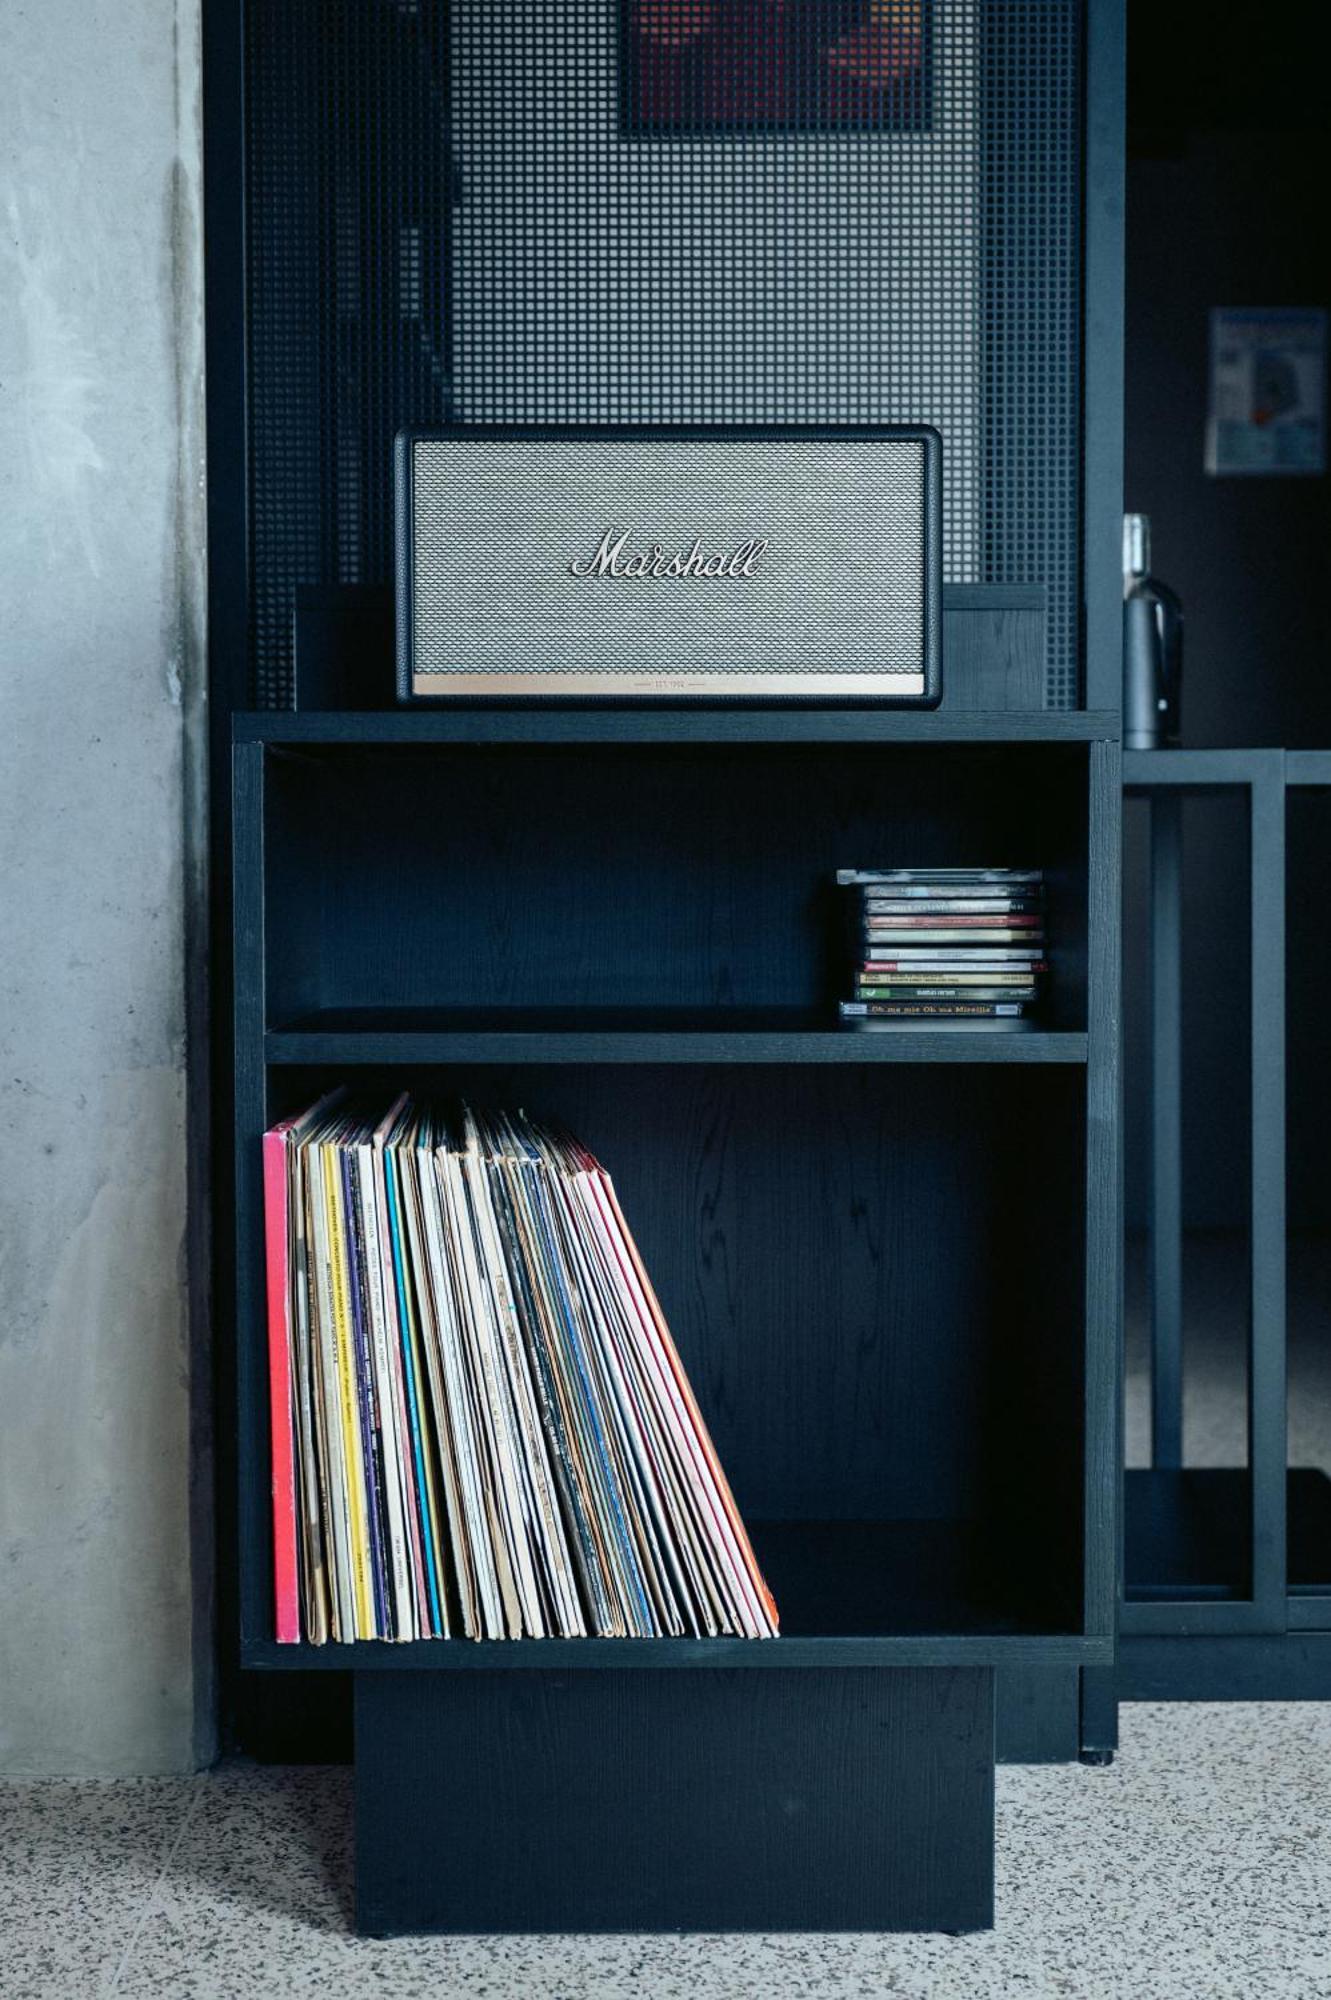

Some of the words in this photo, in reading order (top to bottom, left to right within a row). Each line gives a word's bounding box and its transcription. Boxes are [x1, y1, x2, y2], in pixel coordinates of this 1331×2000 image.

[571, 527, 769, 577] Marshall
[871, 1005, 885, 1013] Oh
[955, 1005, 991, 1013] Mireille
